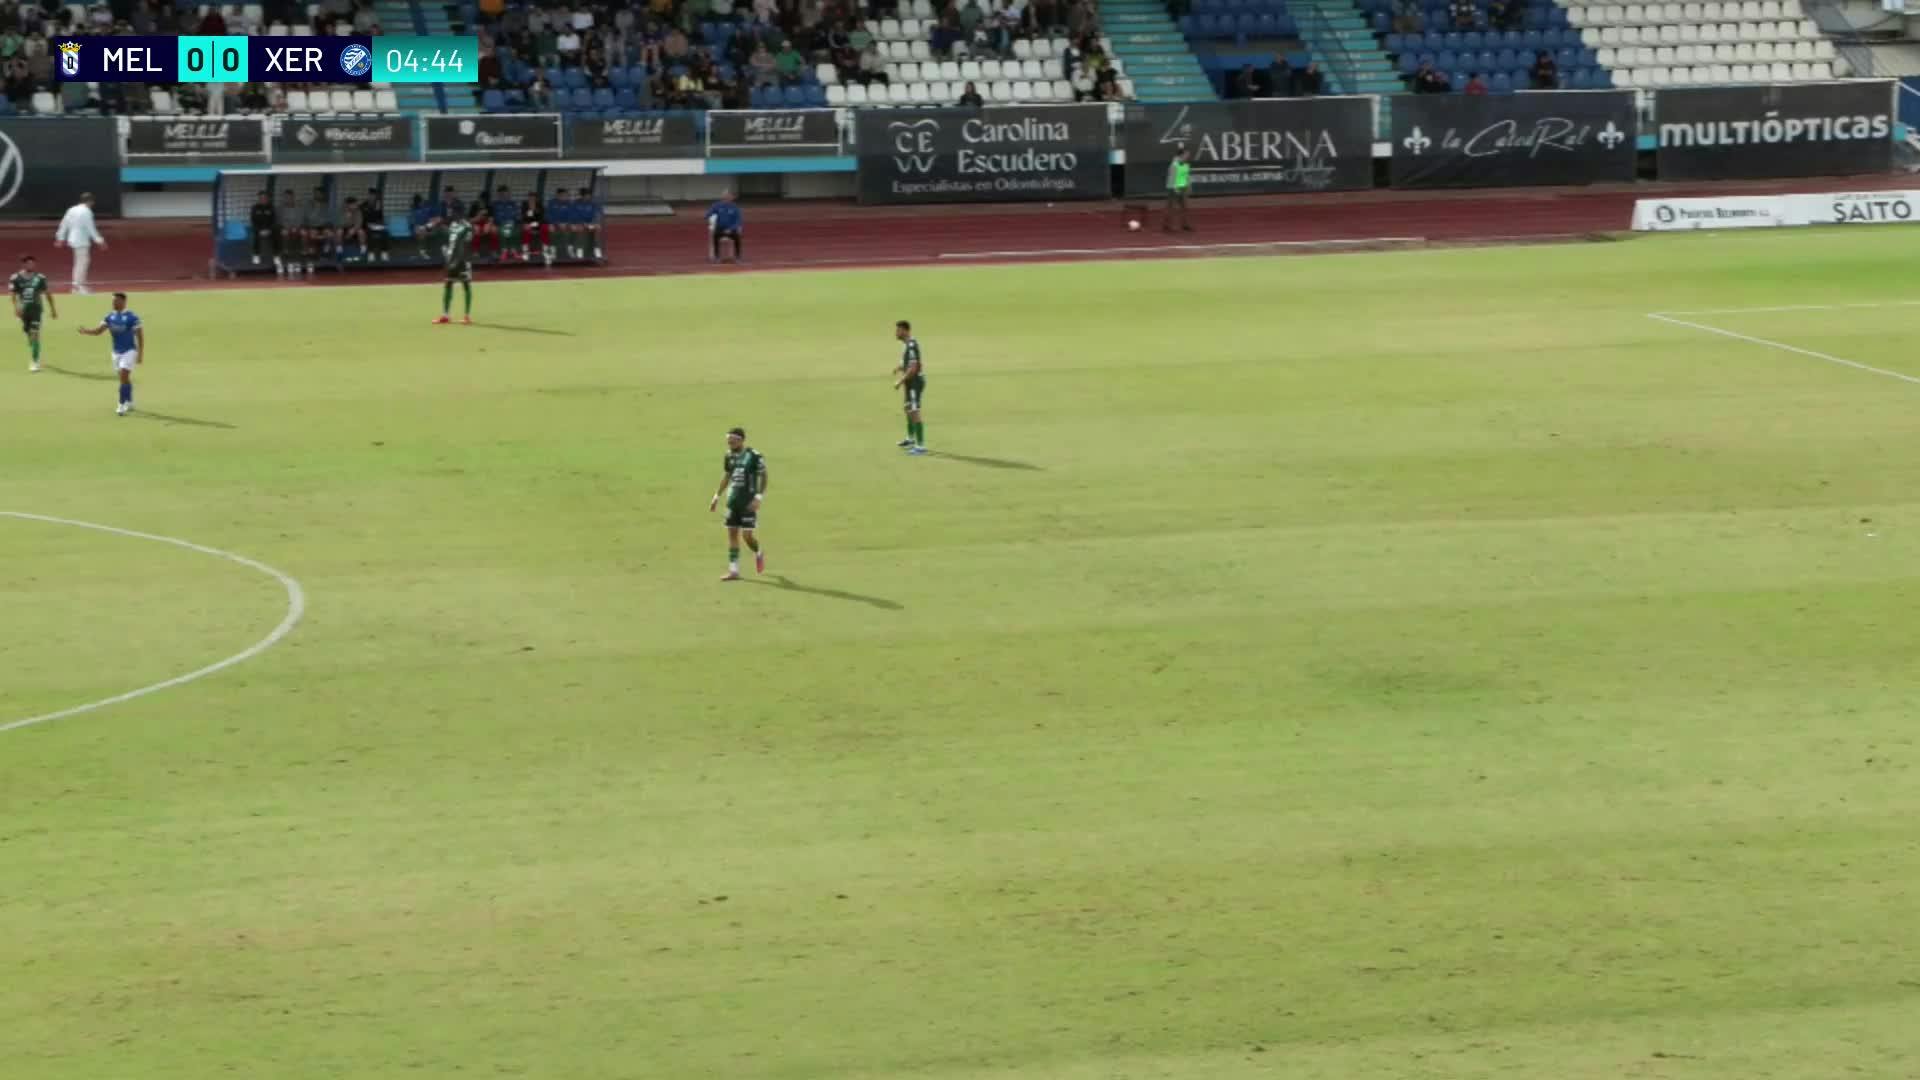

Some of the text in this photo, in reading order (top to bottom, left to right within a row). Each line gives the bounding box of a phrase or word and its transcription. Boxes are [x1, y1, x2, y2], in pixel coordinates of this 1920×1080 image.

[961, 117, 1070, 143] Carolina
[957, 148, 1078, 174] Escudero
[1832, 200, 1912, 222] SAITO
